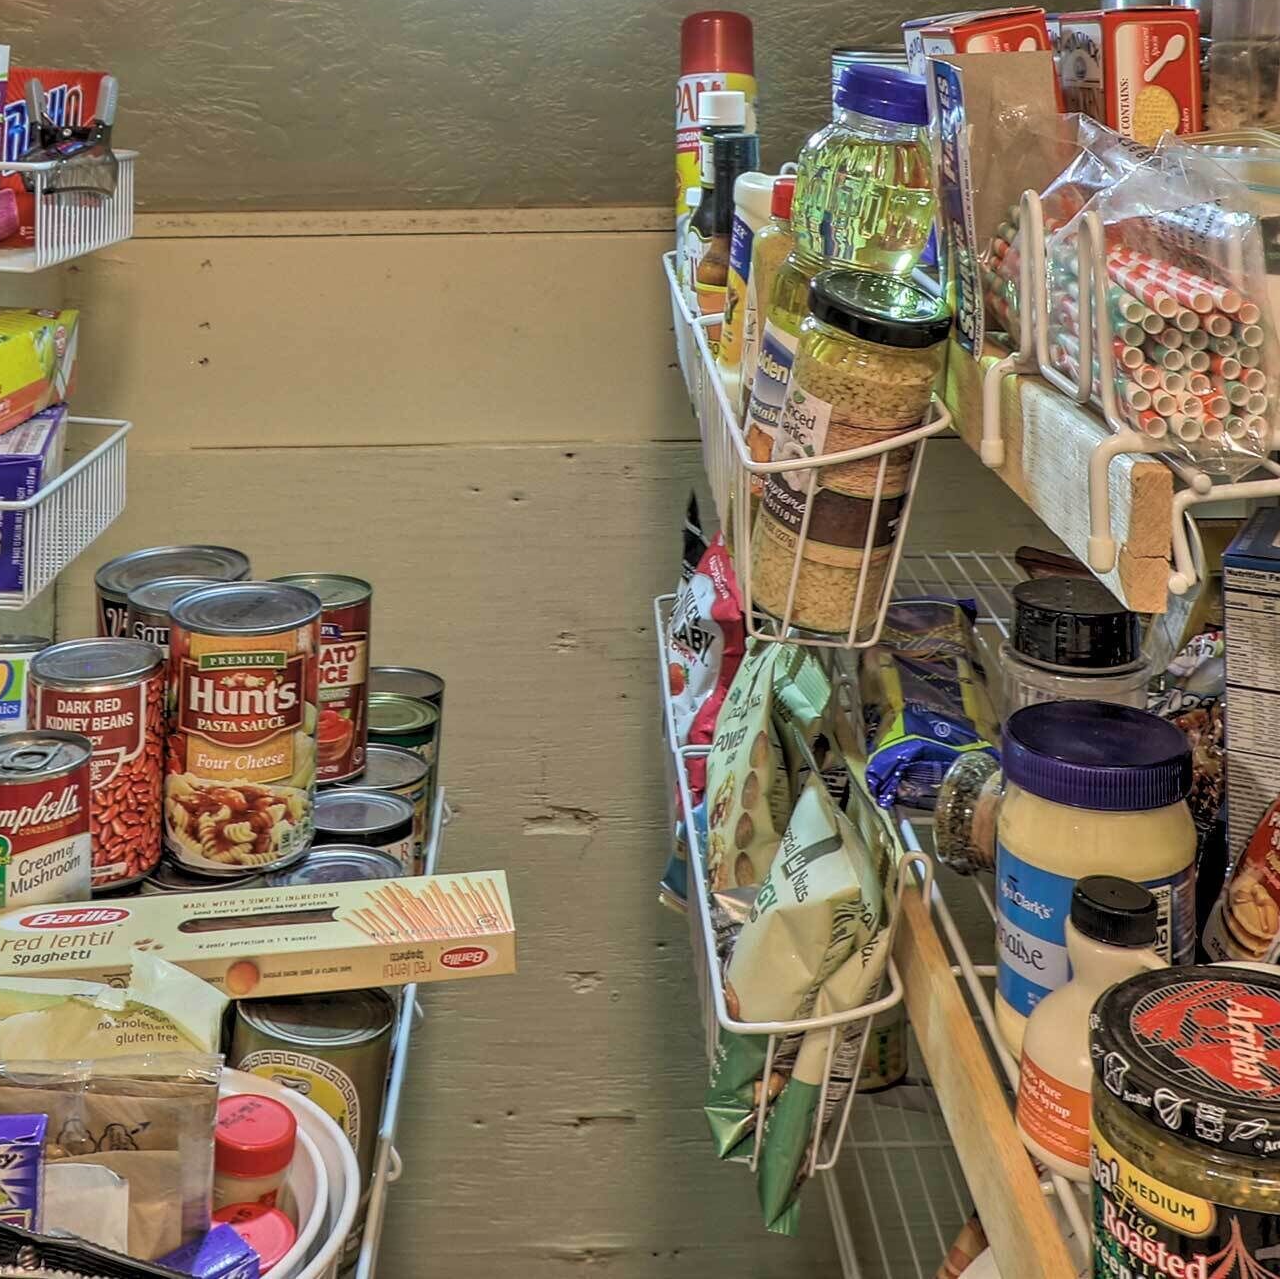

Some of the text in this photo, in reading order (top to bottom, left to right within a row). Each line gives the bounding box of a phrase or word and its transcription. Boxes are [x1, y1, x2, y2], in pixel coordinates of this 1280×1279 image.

[1226, 569, 1266, 582] Nutrition
[209, 654, 276, 667] PREMIUM
[57, 698, 122, 714] DARK RED
[189, 674, 298, 716] Hunt's
[46, 714, 134, 732] KIDNEY BEANS
[196, 715, 286, 733] PASTA SAUCE
[712, 725, 749, 754] POWER
[196, 750, 285, 770] Four Cheese
[18, 847, 65, 878] Cream
[10, 854, 81, 898] Mushroom
[791, 862, 810, 904] Nuts
[1013, 892, 1052, 920] Clark's
[29, 910, 124, 927] Barilla
[0, 930, 114, 953] red lentil
[11, 950, 92, 967] Spaghetti
[442, 951, 486, 965] Barilla
[115, 1031, 180, 1047] gluten free
[1227, 999, 1274, 1091] Arriba!
[1038, 1078, 1062, 1101] Pure
[1040, 1094, 1072, 1120] Syrup
[1128, 1175, 1196, 1222] MEDIUM
[1103, 1196, 1208, 1279] Roasted
